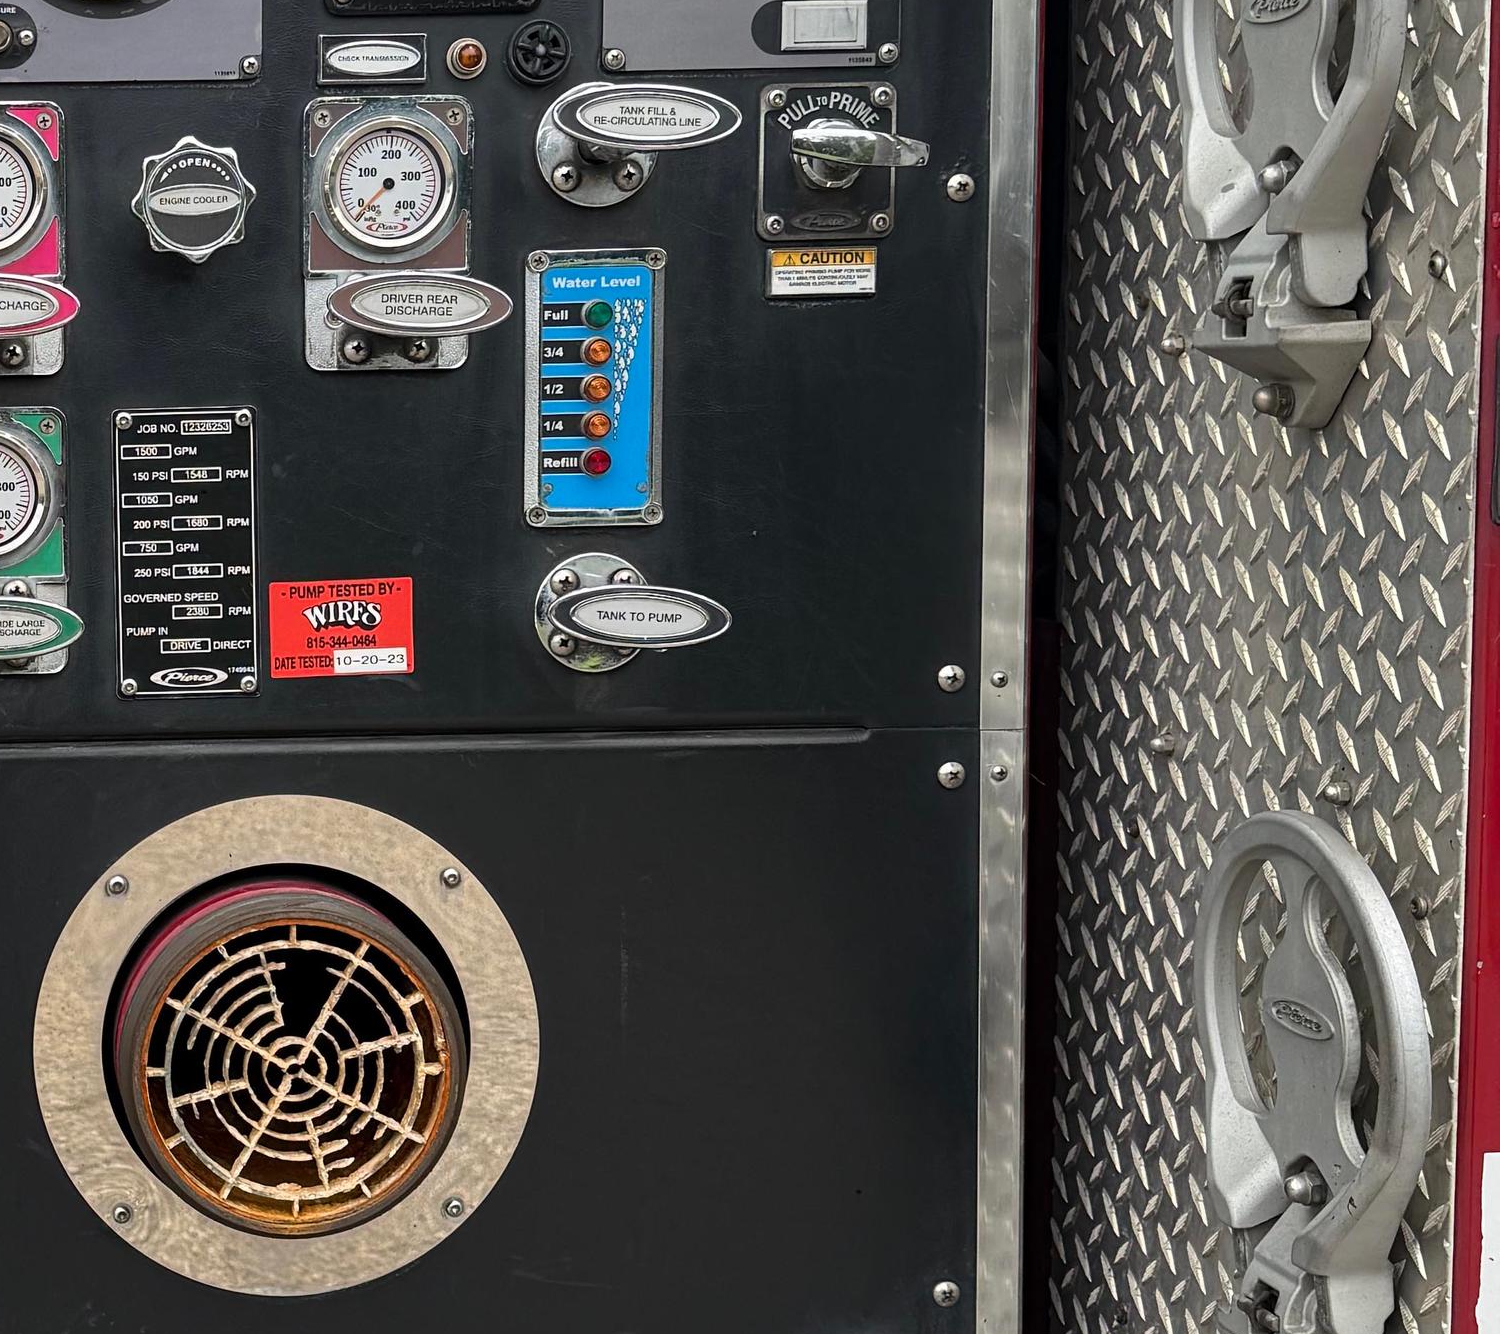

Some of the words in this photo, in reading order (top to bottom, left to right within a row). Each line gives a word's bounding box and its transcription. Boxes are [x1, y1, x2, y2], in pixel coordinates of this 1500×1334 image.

[619, 106, 645, 116] TANK
[647, 106, 668, 116] FILL
[669, 107, 677, 116] &
[777, 95, 820, 130] PULL
[816, 95, 828, 106] TO
[828, 91, 880, 129] PRIME
[593, 116, 677, 126] RE-CIRCULATING
[679, 118, 702, 127] LINE
[178, 157, 211, 169] OPEN
[159, 196, 191, 206] ENGINE
[193, 196, 228, 204] COOLER
[800, 252, 865, 265] CAUTION
[552, 277, 597, 289] Water
[600, 275, 641, 288] Level
[381, 294, 424, 305] DRIVER
[426, 294, 458, 305] REAR
[384, 305, 453, 317] DISCHARGE
[543, 310, 569, 321] Full
[543, 347, 564, 358] 3/4
[543, 384, 564, 395] 1/2
[136, 424, 157, 434] JOB
[160, 424, 179, 434] NO.
[543, 420, 564, 432] 1/4
[135, 446, 158, 457] 1500
[174, 446, 198, 456] GPM
[543, 457, 579, 468] Refill
[132, 472, 150, 482] 150
[151, 471, 168, 481] PSI
[184, 470, 208, 480] 1548
[225, 469, 249, 479] RPM
[139, 543, 157, 553] 750
[175, 543, 199, 553] GPM
[134, 568, 152, 578] 250
[154, 567, 171, 577] PSI
[187, 566, 210, 576] 1844
[227, 565, 251, 575] RPM
[289, 585, 325, 599] PUMP
[328, 583, 375, 598] TESTED
[378, 582, 395, 595] BY
[123, 593, 182, 604] GOVERNED
[184, 592, 219, 602] SPEED
[186, 606, 210, 616] 2380
[228, 606, 252, 616] RPM
[302, 600, 382, 631] WIRFS
[596, 610, 627, 621] TANK
[629, 612, 645, 622] TO
[648, 612, 682, 623] PUMP
[126, 627, 156, 637] PUMP
[158, 626, 169, 636] IN
[170, 640, 202, 650] DRIVE
[213, 640, 252, 650] DIRECT
[274, 656, 296, 670] DATE
[297, 655, 334, 669] TESTED:
[336, 654, 405, 666] 10-20-23
[165, 670, 215, 685] Pierce
